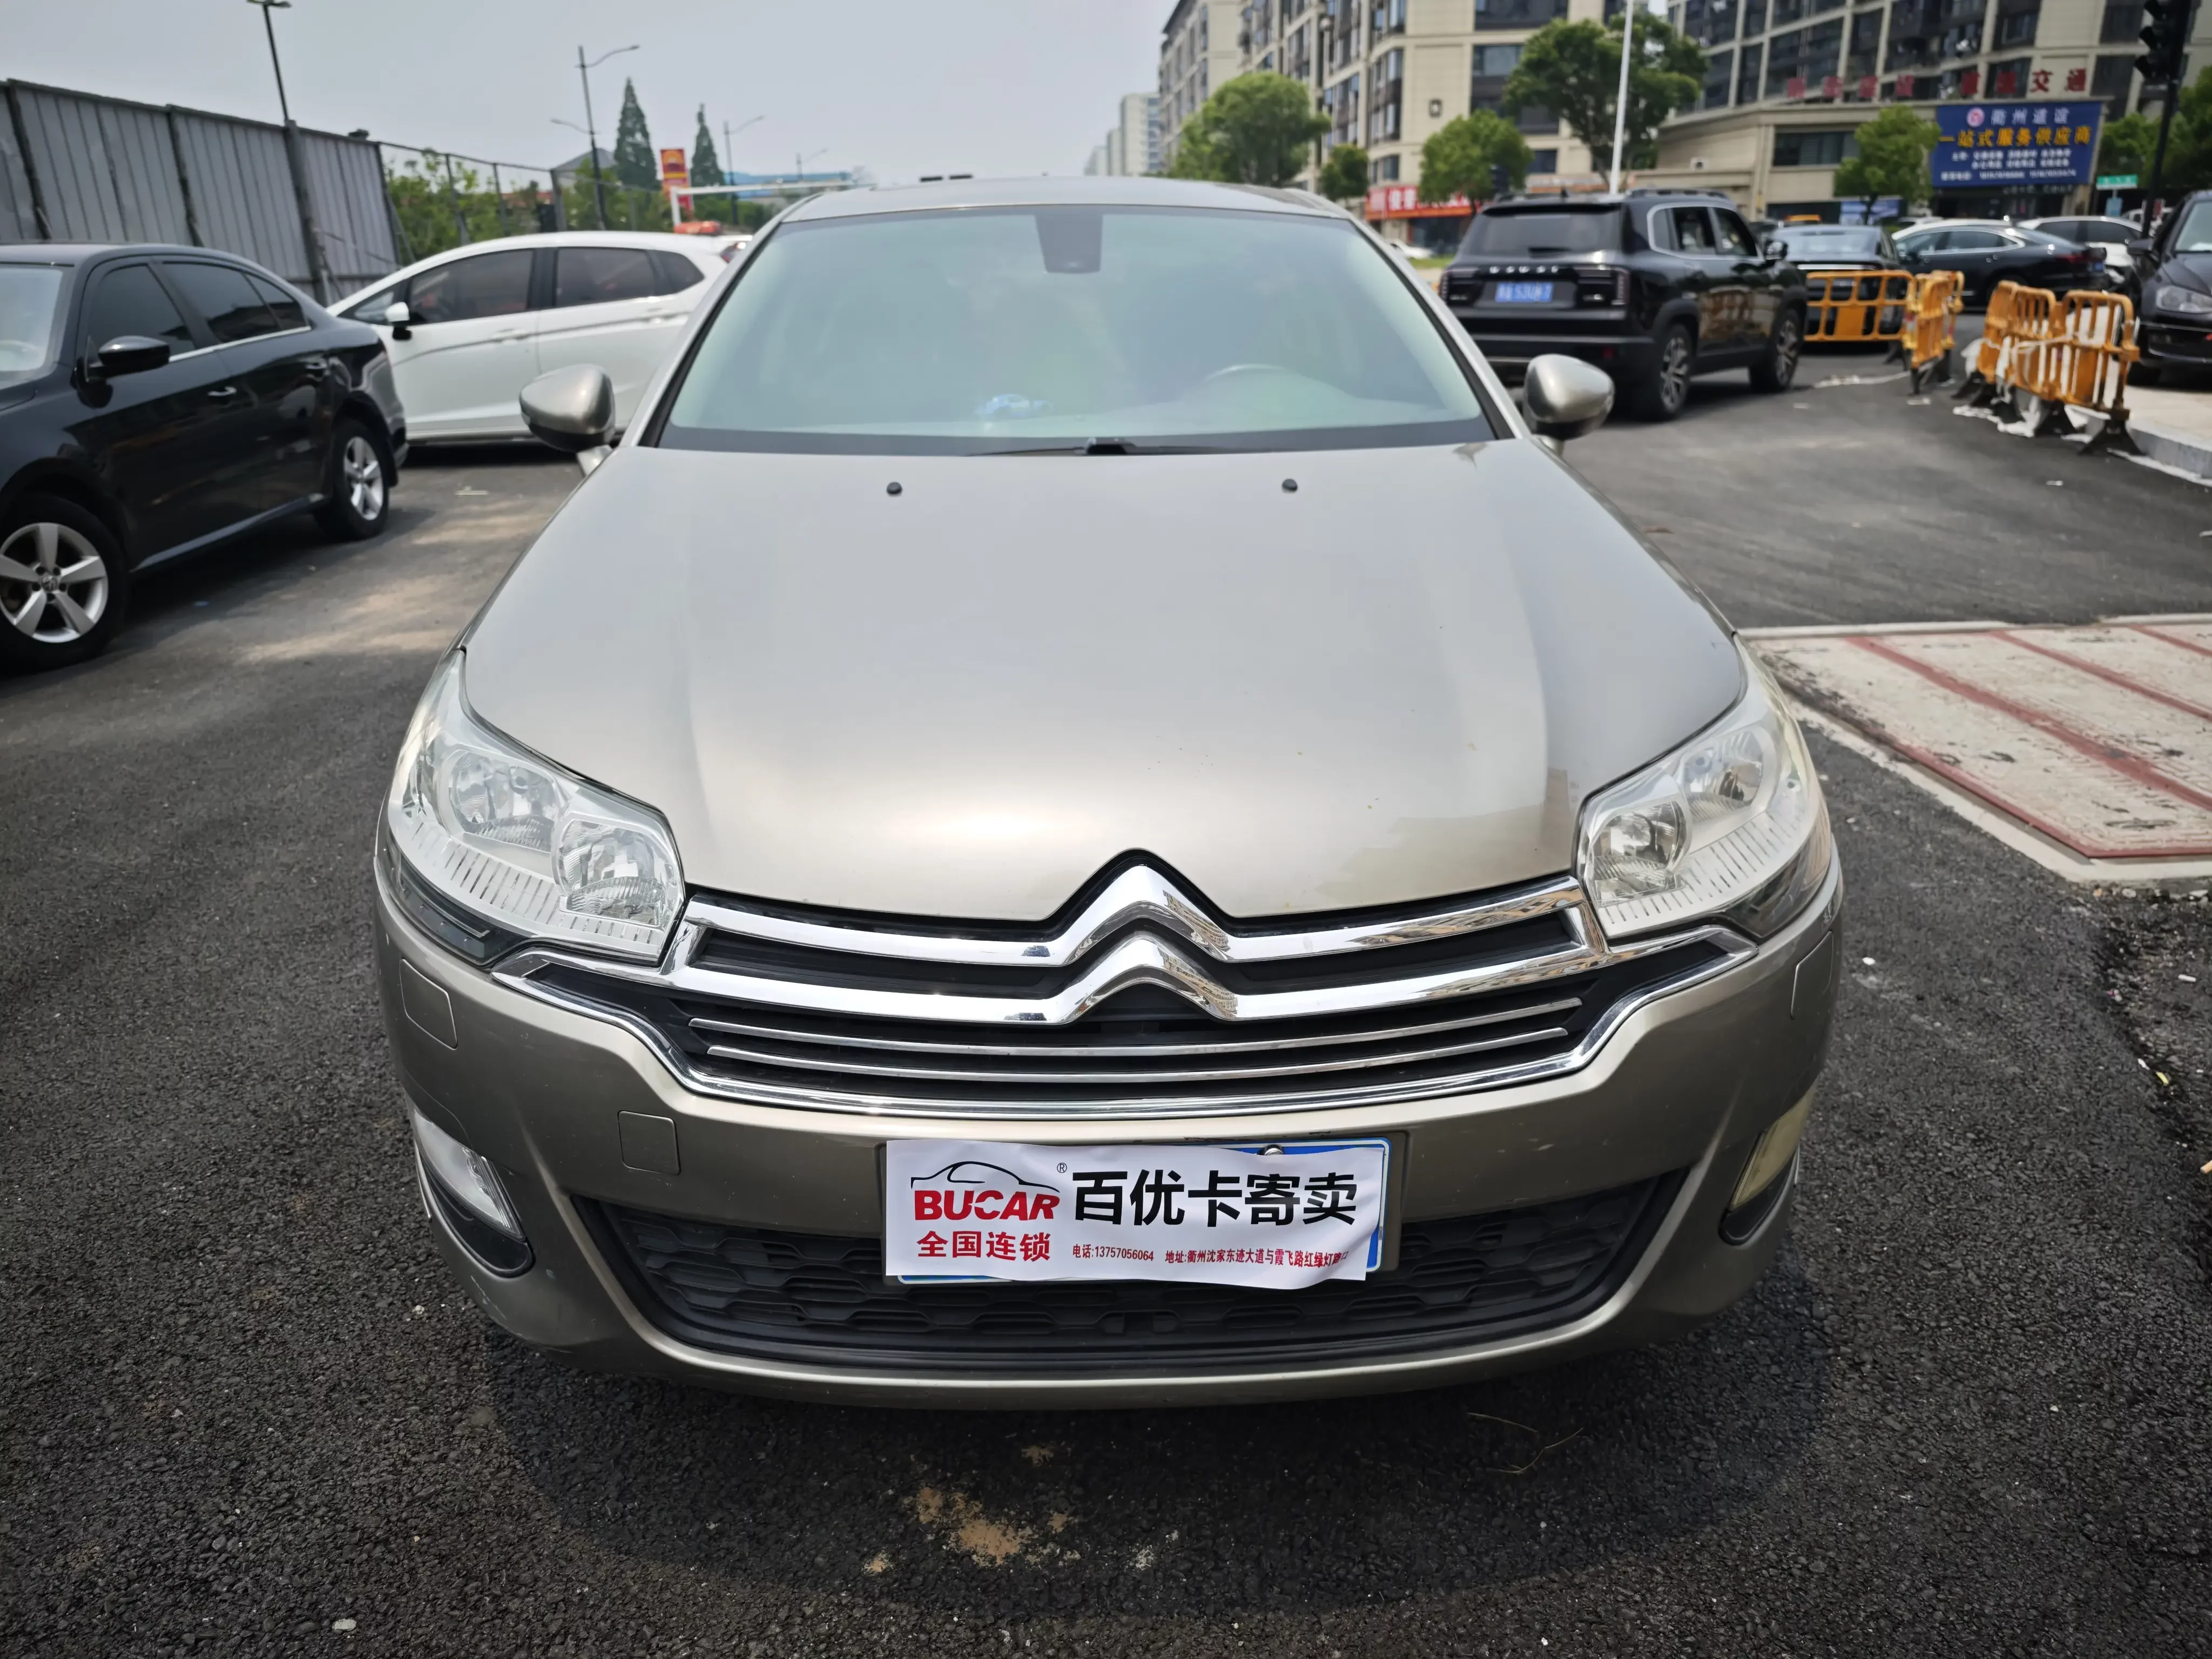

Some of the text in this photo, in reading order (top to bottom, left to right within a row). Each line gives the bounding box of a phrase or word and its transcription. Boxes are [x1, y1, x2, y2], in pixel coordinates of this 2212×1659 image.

[914, 1190, 1060, 1220] BUCAR
[1073, 1169, 1357, 1228] 百优卡寄卖
[916, 1230, 1051, 1262] 全国连锁
